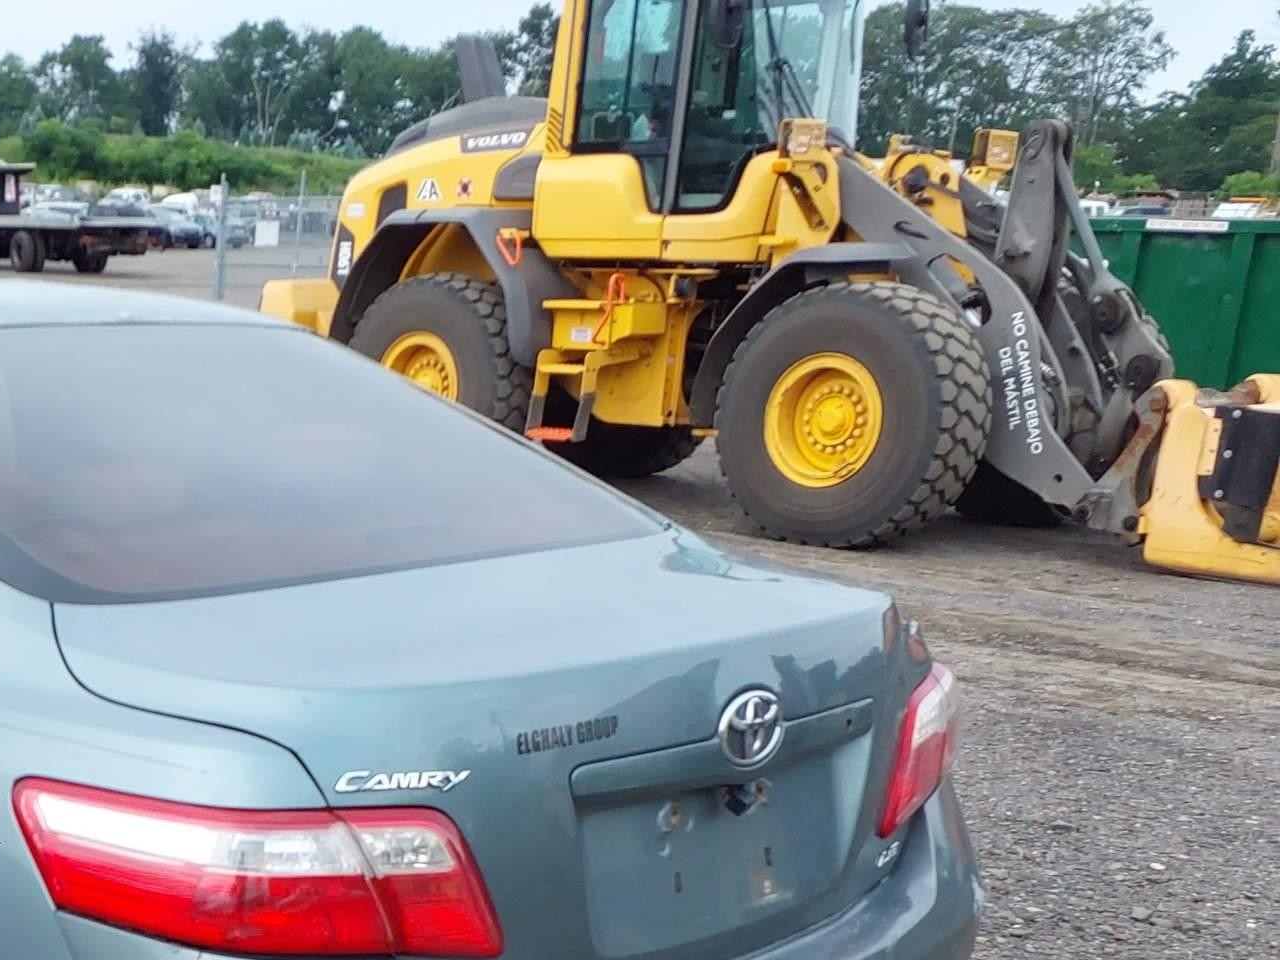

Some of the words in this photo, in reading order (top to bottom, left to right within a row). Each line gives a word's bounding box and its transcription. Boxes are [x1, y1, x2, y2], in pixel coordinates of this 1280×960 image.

[466, 131, 526, 149] VOLVO
[1011, 311, 1026, 337] NO
[998, 346, 1015, 376] DEL
[1015, 338, 1036, 398] CAMINE
[1023, 398, 1043, 455] DEBAJO
[575, 715, 618, 744] GROUP
[334, 769, 472, 793] CAMRY
